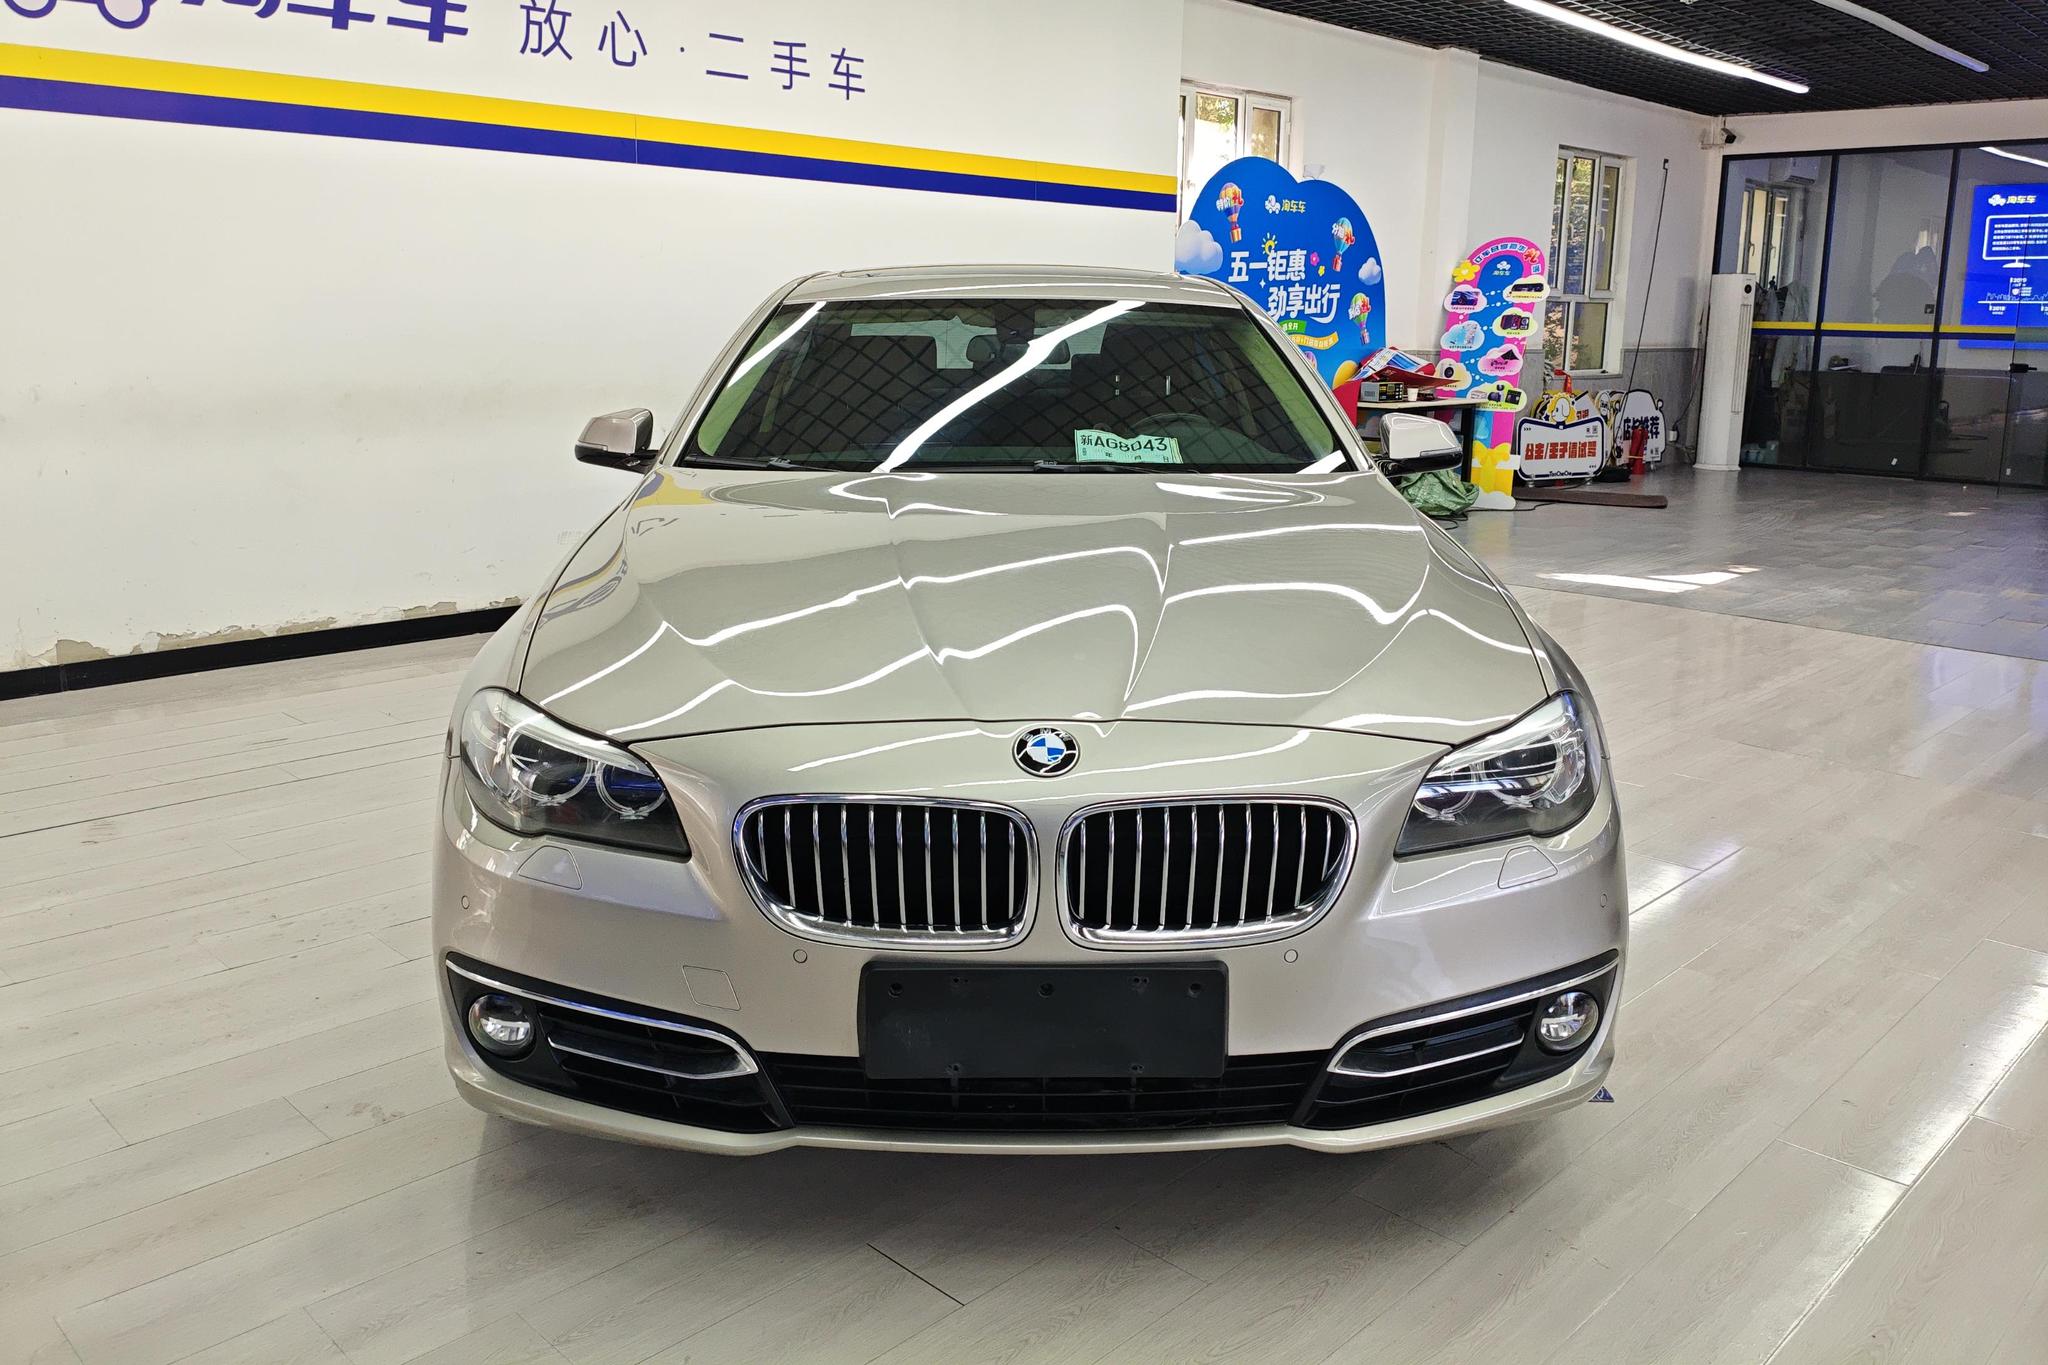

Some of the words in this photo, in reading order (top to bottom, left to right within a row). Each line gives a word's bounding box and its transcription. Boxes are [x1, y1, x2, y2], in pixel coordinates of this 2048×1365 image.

[1228, 248, 1307, 282] 五一钜惠
[1267, 283, 1341, 324] 劲享出行
[1080, 434, 1168, 452] 新AG8043
